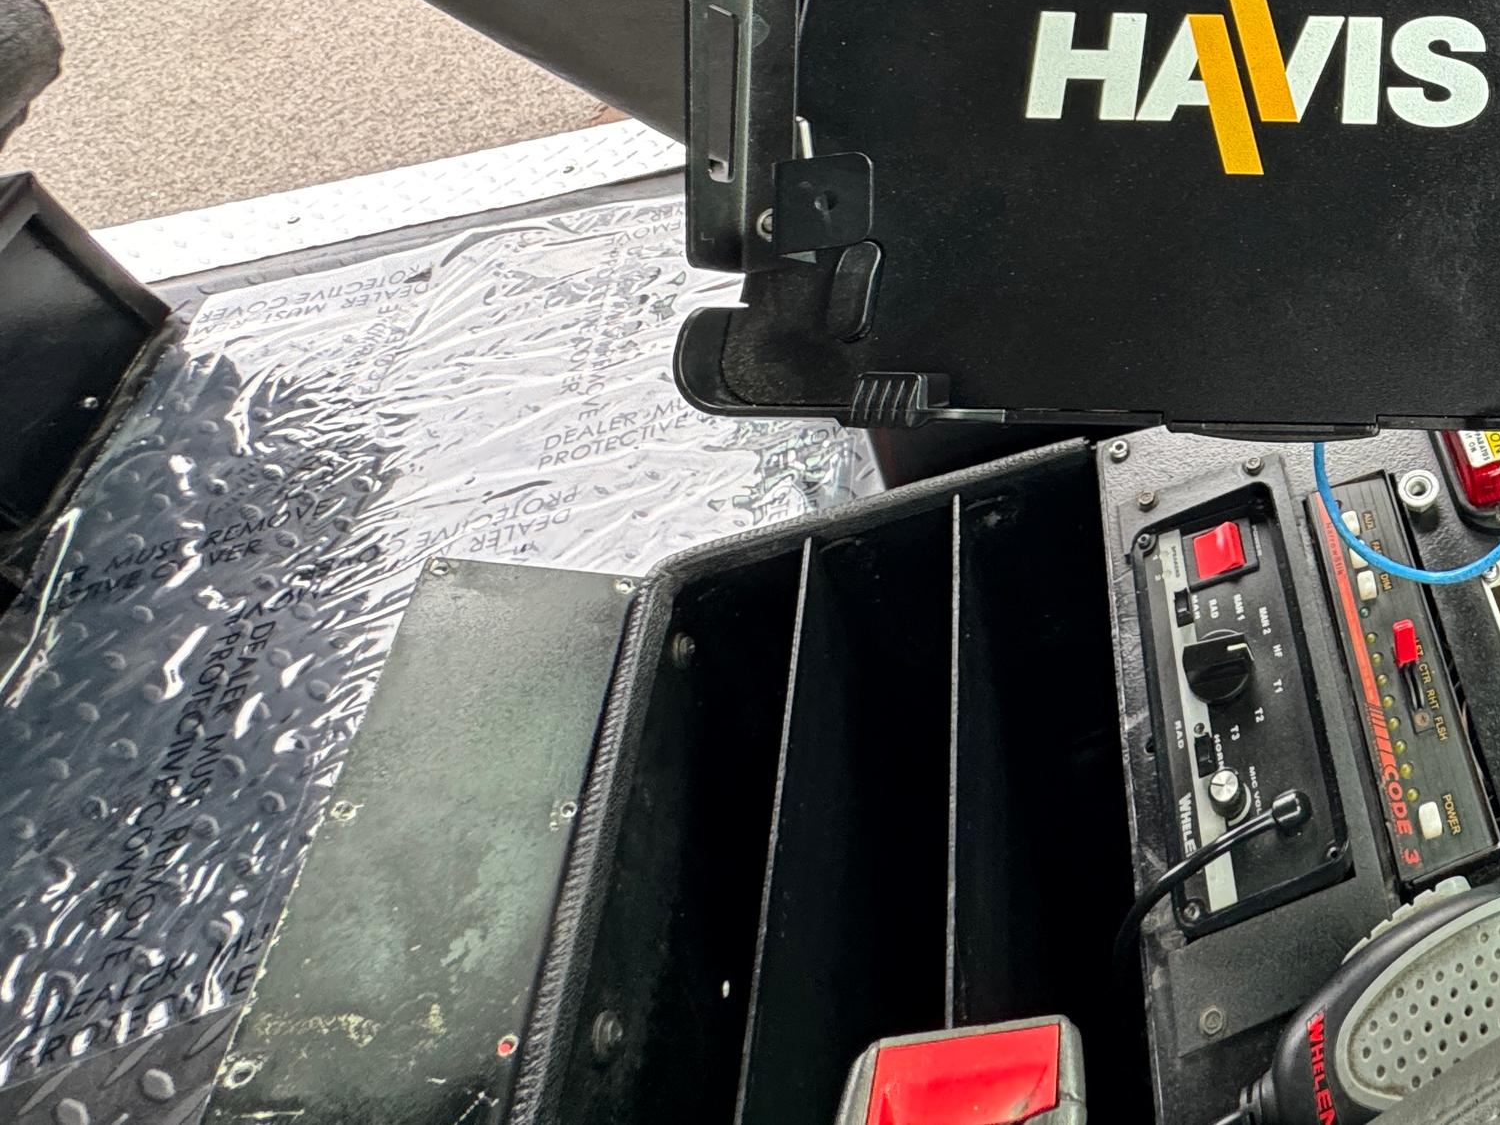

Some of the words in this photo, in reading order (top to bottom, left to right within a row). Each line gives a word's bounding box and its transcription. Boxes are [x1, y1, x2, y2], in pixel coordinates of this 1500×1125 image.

[198, 295, 288, 324] COVER
[341, 281, 432, 311] DEALER
[538, 411, 687, 470] PROTECTIVE
[543, 411, 638, 452] DEALER
[416, 484, 579, 549] PROTECTIVE
[469, 506, 573, 555] DEALER
[104, 536, 188, 573] MUST
[202, 497, 336, 547] REMOVE
[1381, 573, 1392, 591] DIM
[1209, 598, 1219, 619] RAD
[1234, 593, 1245, 614] MAN
[1259, 606, 1270, 628] MAN
[1272, 644, 1283, 658] HF
[213, 621, 277, 717] DEALER
[1418, 663, 1431, 684] CTR
[1273, 679, 1284, 693] T1
[1426, 689, 1440, 710] RHT
[149, 632, 236, 797] PROTECTIVE
[1255, 707, 1265, 723] T2
[1433, 715, 1449, 741] FLSH
[1174, 720, 1184, 750] RAD
[1230, 725, 1241, 741] T3
[1213, 734, 1224, 770] HORN
[186, 733, 227, 807] MUST
[1249, 766, 1258, 788] MIC
[1254, 791, 1263, 816] VOL
[1178, 792, 1197, 858] WHELE
[1382, 763, 1414, 836] CODE
[1401, 848, 1422, 865] 3
[1443, 793, 1461, 836] POWER
[90, 801, 168, 925] COVER
